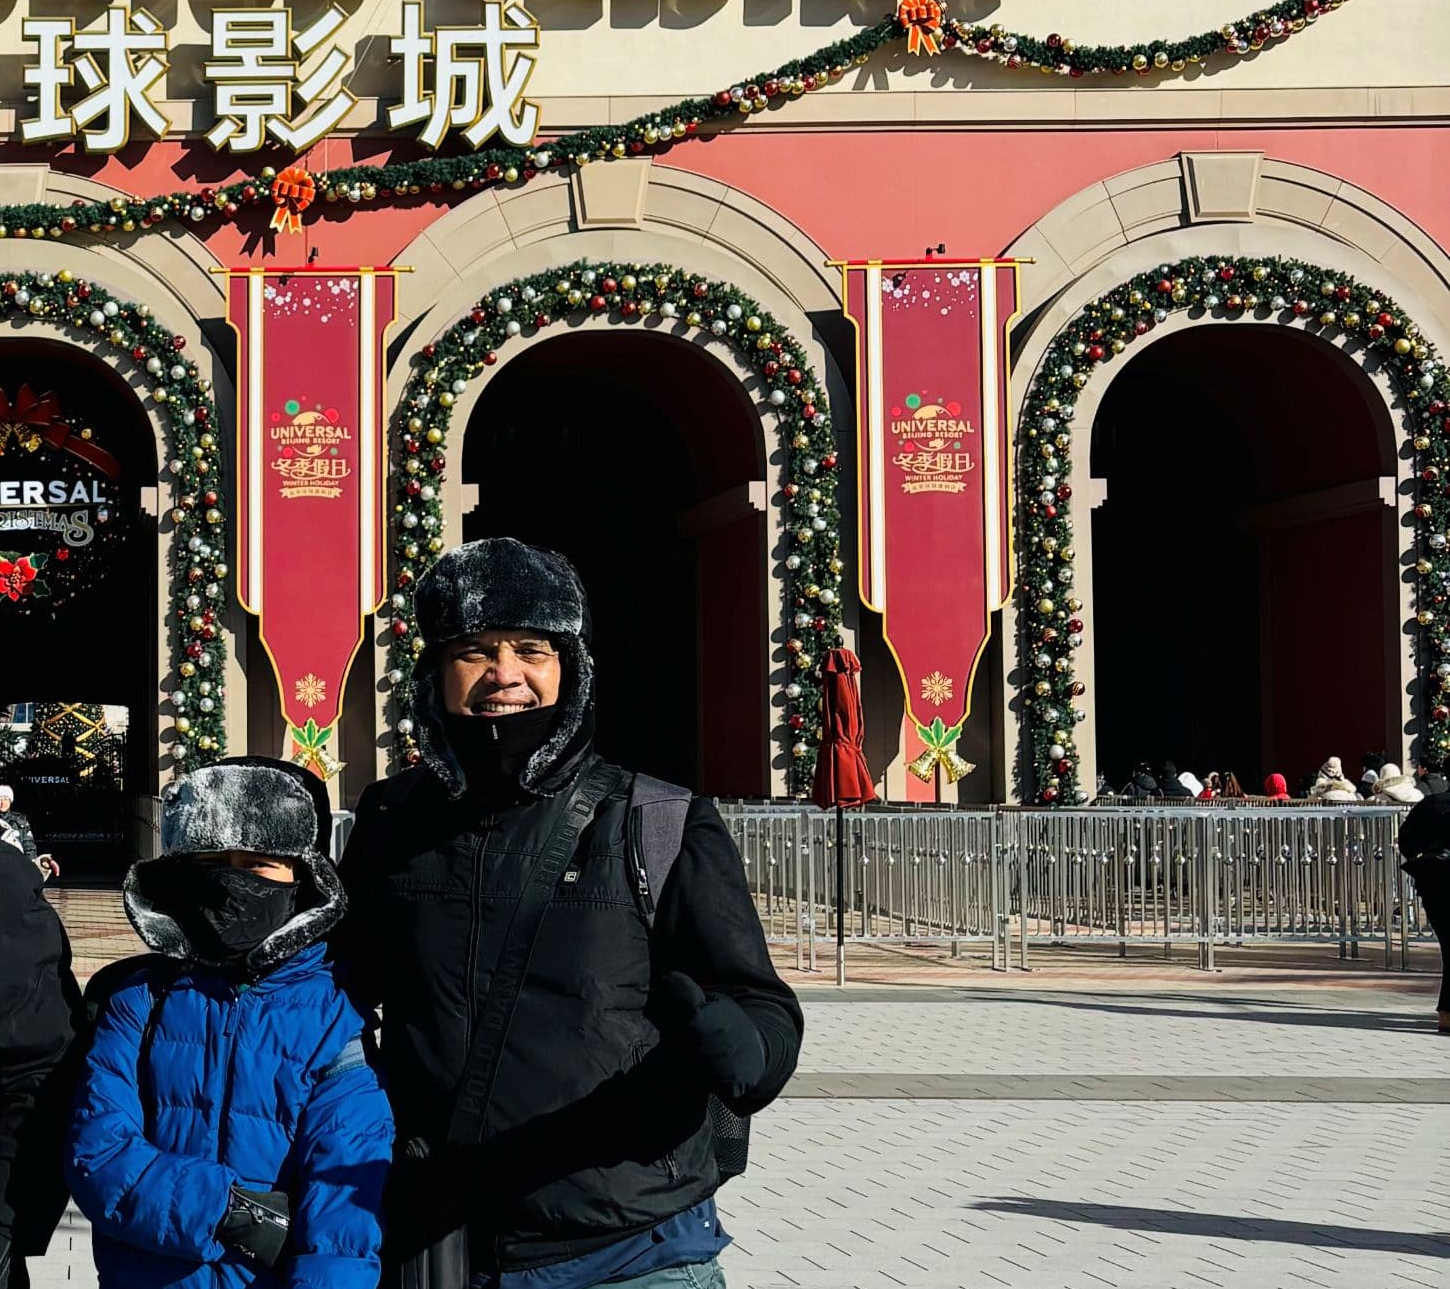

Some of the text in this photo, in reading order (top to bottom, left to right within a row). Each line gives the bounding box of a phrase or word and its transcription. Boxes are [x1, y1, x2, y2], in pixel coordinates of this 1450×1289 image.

[270, 425, 351, 440] UNIVERSAL
[891, 419, 975, 434] UNIVERSAL
[935, 431, 963, 439] RESORT
[271, 457, 351, 480] 冬季假日
[892, 451, 975, 474] 冬季假日
[21, 776, 70, 784] IVERSAL
